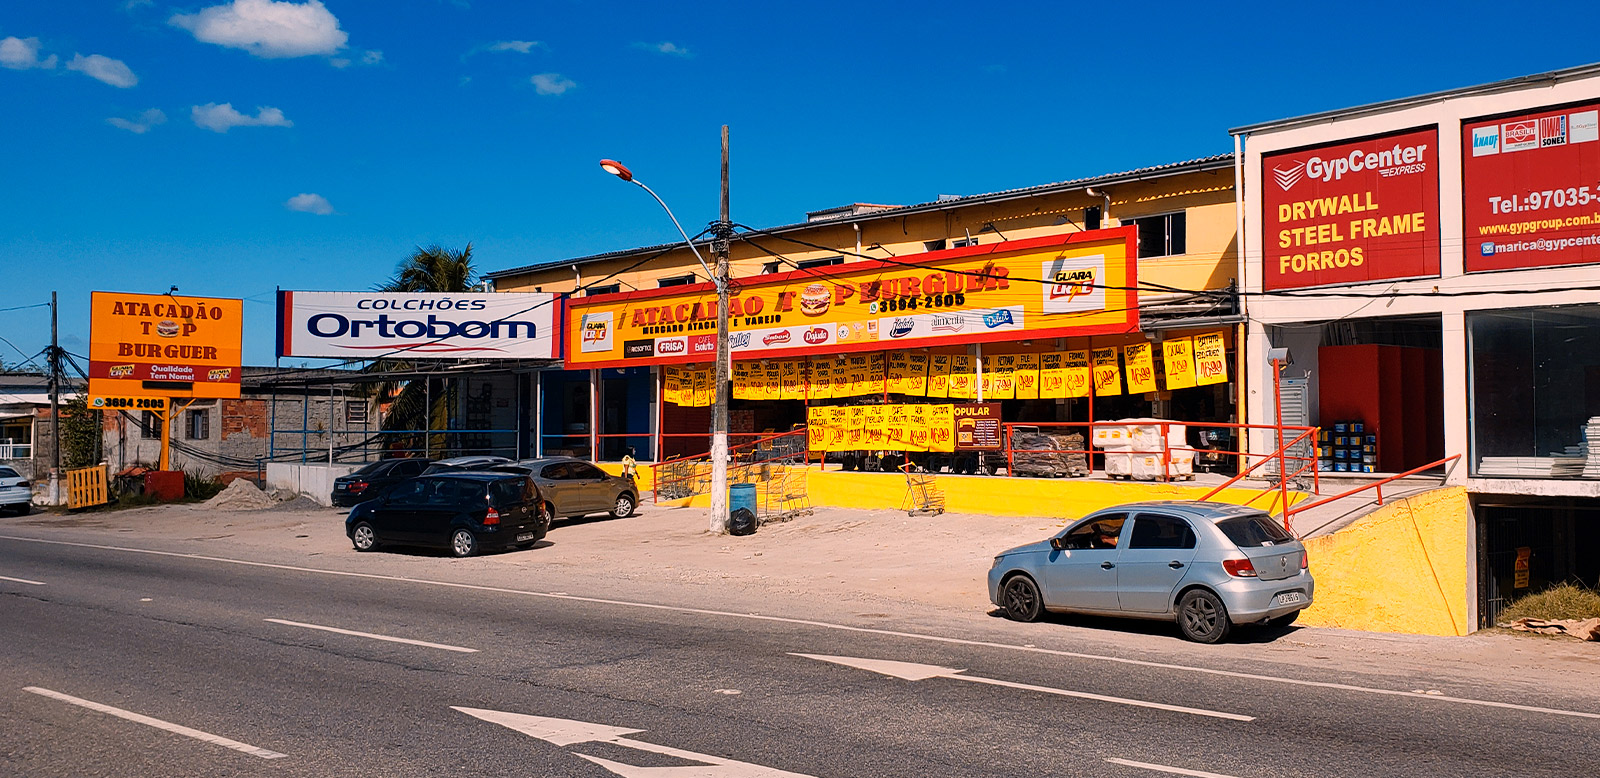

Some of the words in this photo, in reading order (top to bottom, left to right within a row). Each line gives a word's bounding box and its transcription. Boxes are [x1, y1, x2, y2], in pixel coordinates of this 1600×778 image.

[1505, 128, 1536, 138] BRASILIT
[1541, 117, 1561, 138] OWA
[1542, 136, 1566, 147] SONEX
[1305, 143, 1427, 182] GypCenter
[1388, 162, 1427, 178] EXPRESS
[1278, 191, 1379, 223] DRYWALL
[1278, 223, 1344, 249] STEEL
[1350, 212, 1426, 240] FRAME
[1279, 247, 1364, 275] FORROS
[859, 265, 1011, 304] BURGUER
[1055, 271, 1093, 282] GUARA
[112, 301, 223, 321] ATACADÃO
[356, 297, 487, 311] COLCHÕES
[879, 293, 966, 313] 3694-2605
[307, 313, 537, 338] Ortobom
[642, 323, 684, 336] MERCADO
[687, 320, 719, 332] ATACA
[733, 318, 739, 327] E
[744, 314, 782, 326] VAREJO
[118, 342, 217, 360] BURGUER
[659, 341, 685, 353] FRISA
[150, 372, 167, 380] Tem
[169, 372, 195, 381] Nome!
[151, 365, 193, 374] Qualidade
[105, 397, 134, 408] 3694
[136, 398, 165, 409] 2605
[954, 406, 990, 416] OPULAR
